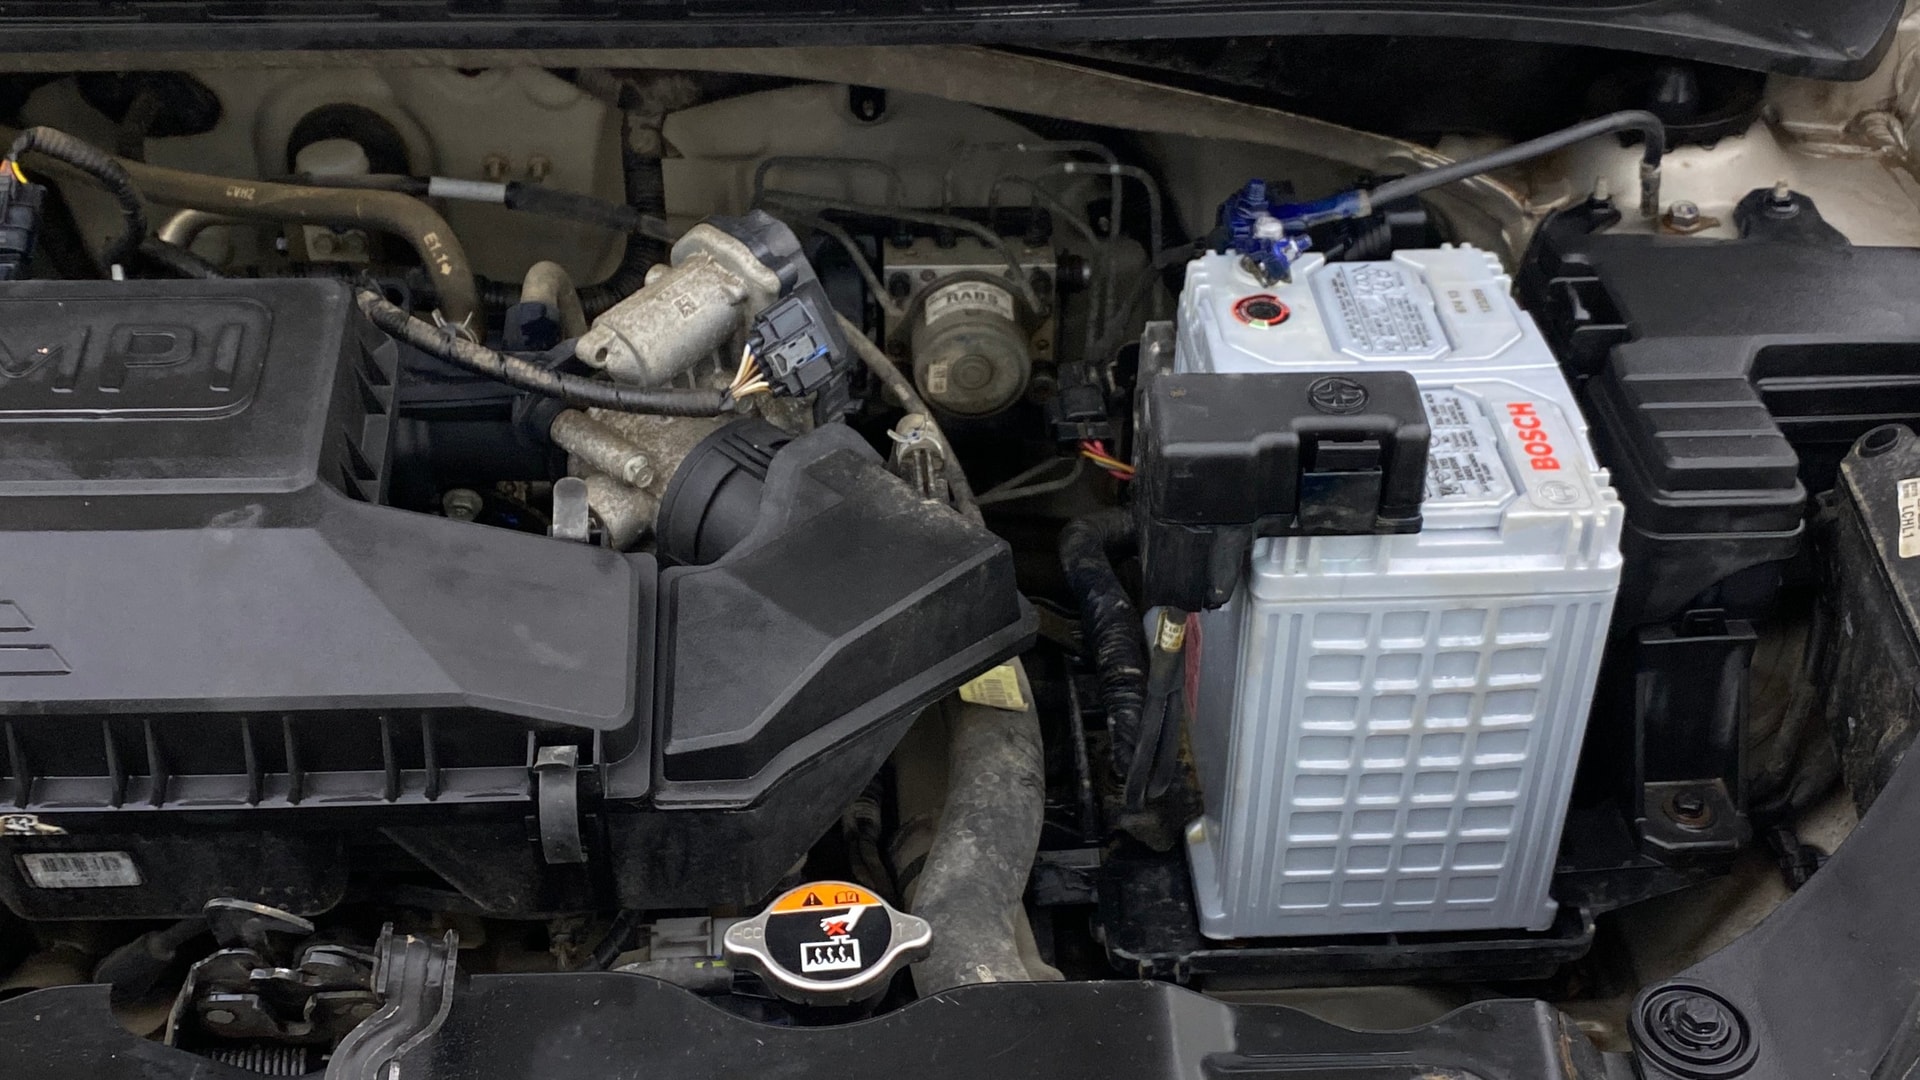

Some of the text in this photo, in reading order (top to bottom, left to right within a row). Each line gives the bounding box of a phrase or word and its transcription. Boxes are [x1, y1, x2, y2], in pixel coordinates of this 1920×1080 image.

[0, 322, 245, 393] MPI
[1506, 402, 1561, 471] BOSCH
[1901, 505, 1915, 538] LCHL1
